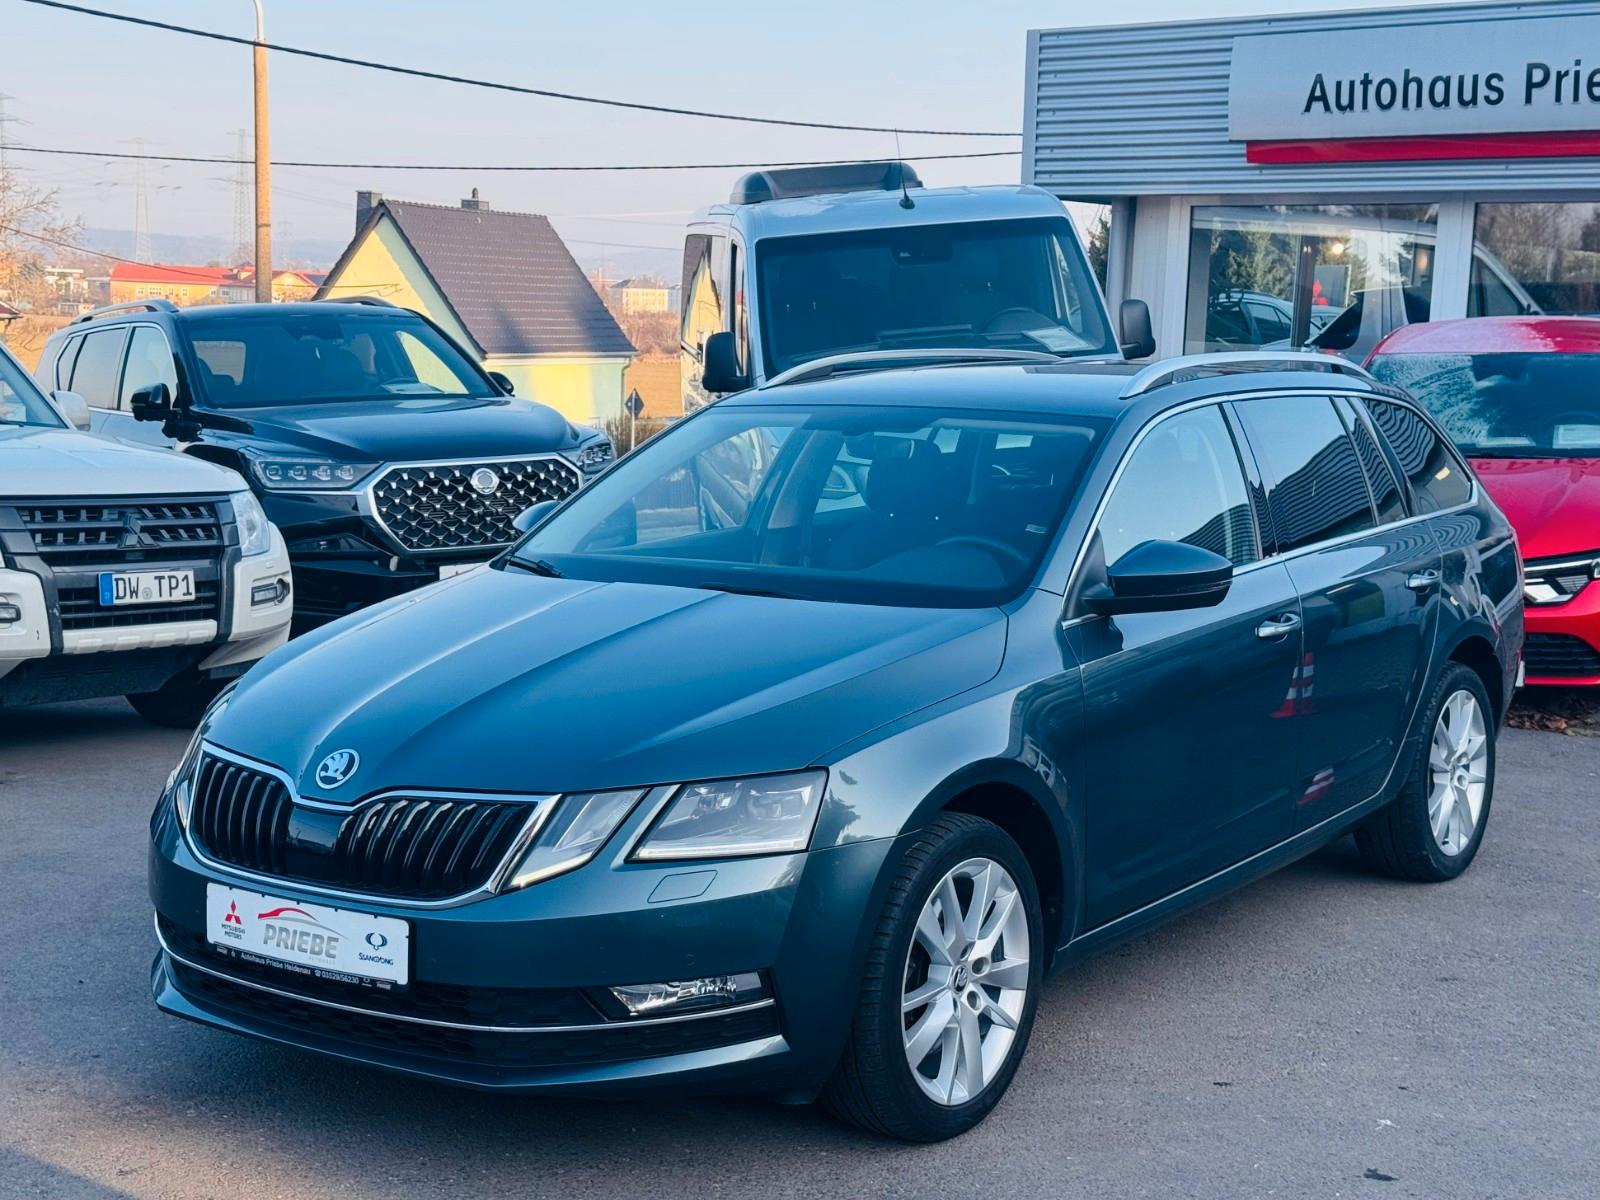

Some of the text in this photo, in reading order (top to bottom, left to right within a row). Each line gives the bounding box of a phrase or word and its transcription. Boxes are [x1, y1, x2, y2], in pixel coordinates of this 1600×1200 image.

[1304, 59, 1600, 113] Autohaus Prie
[114, 574, 192, 600] DW TP1
[263, 923, 339, 959] PRIEBE
